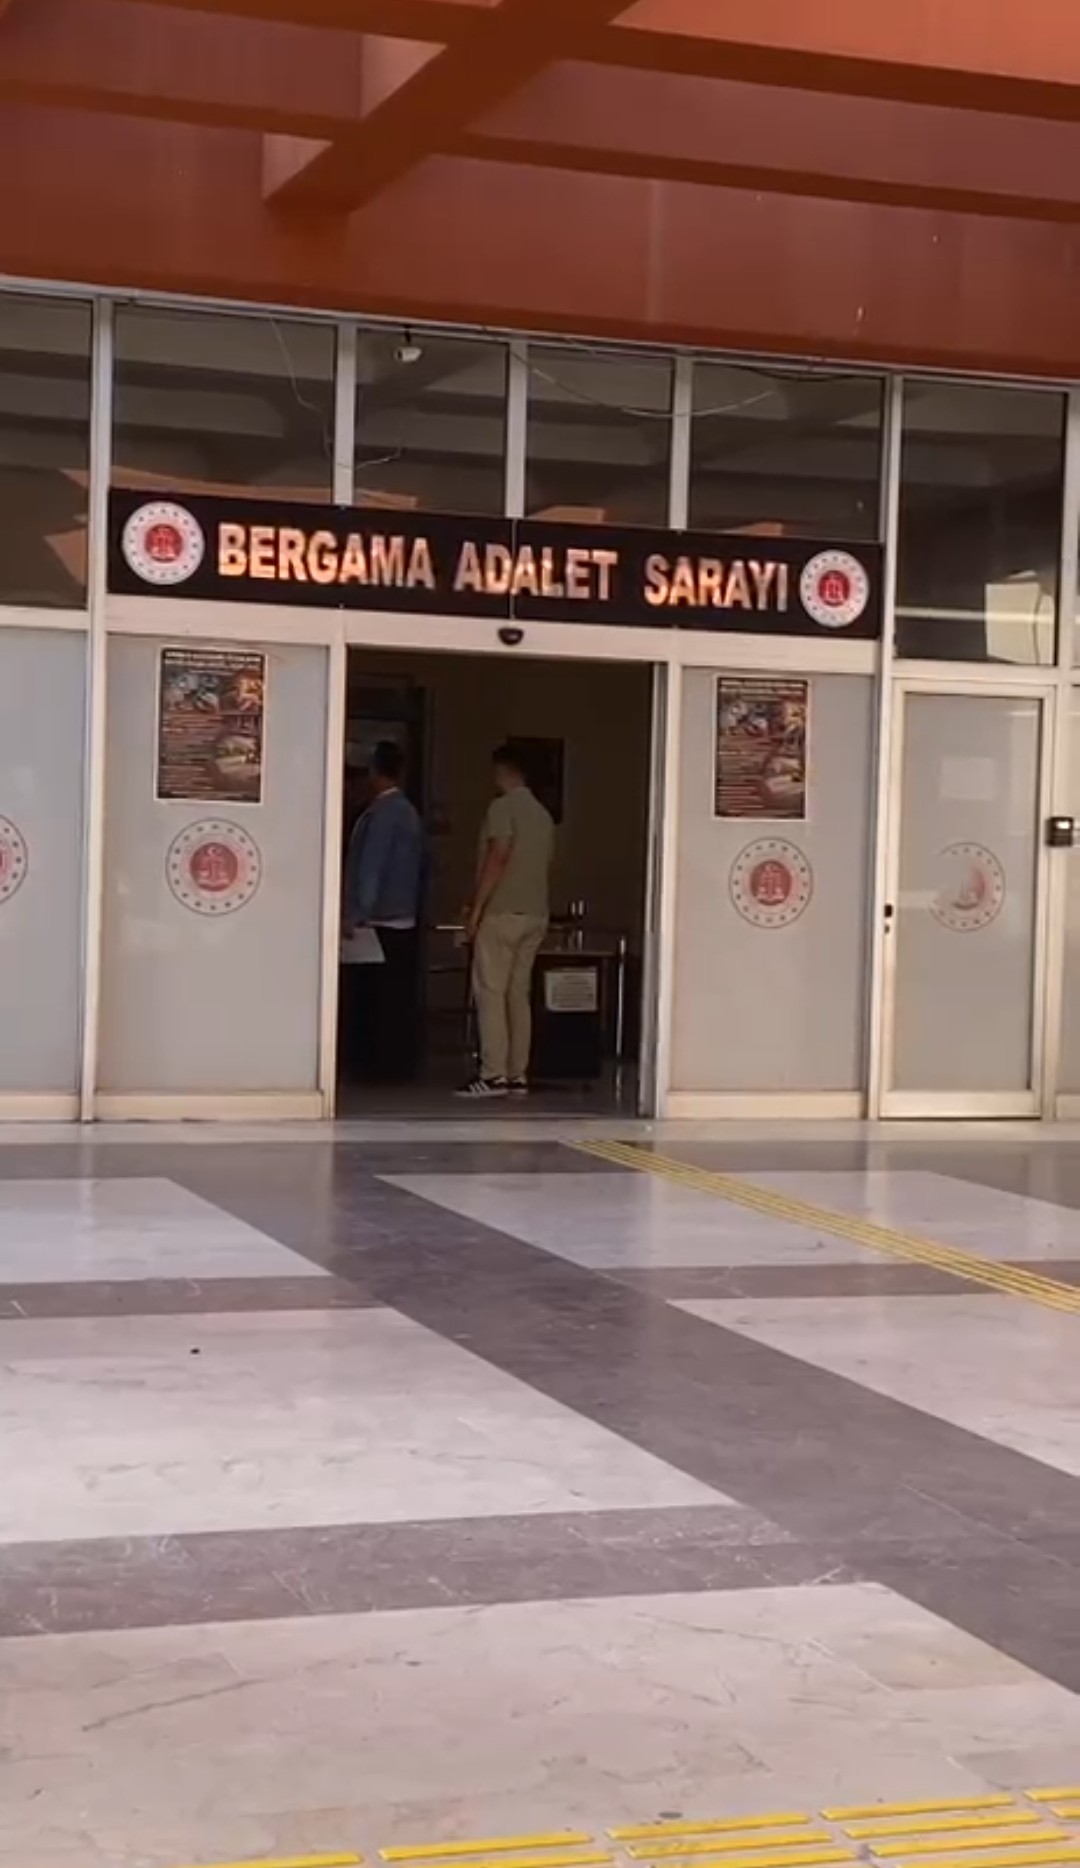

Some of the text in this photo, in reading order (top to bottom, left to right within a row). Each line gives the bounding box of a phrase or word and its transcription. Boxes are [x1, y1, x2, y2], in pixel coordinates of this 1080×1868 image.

[217, 523, 789, 612] BERGAMA ADALET SARAYI
